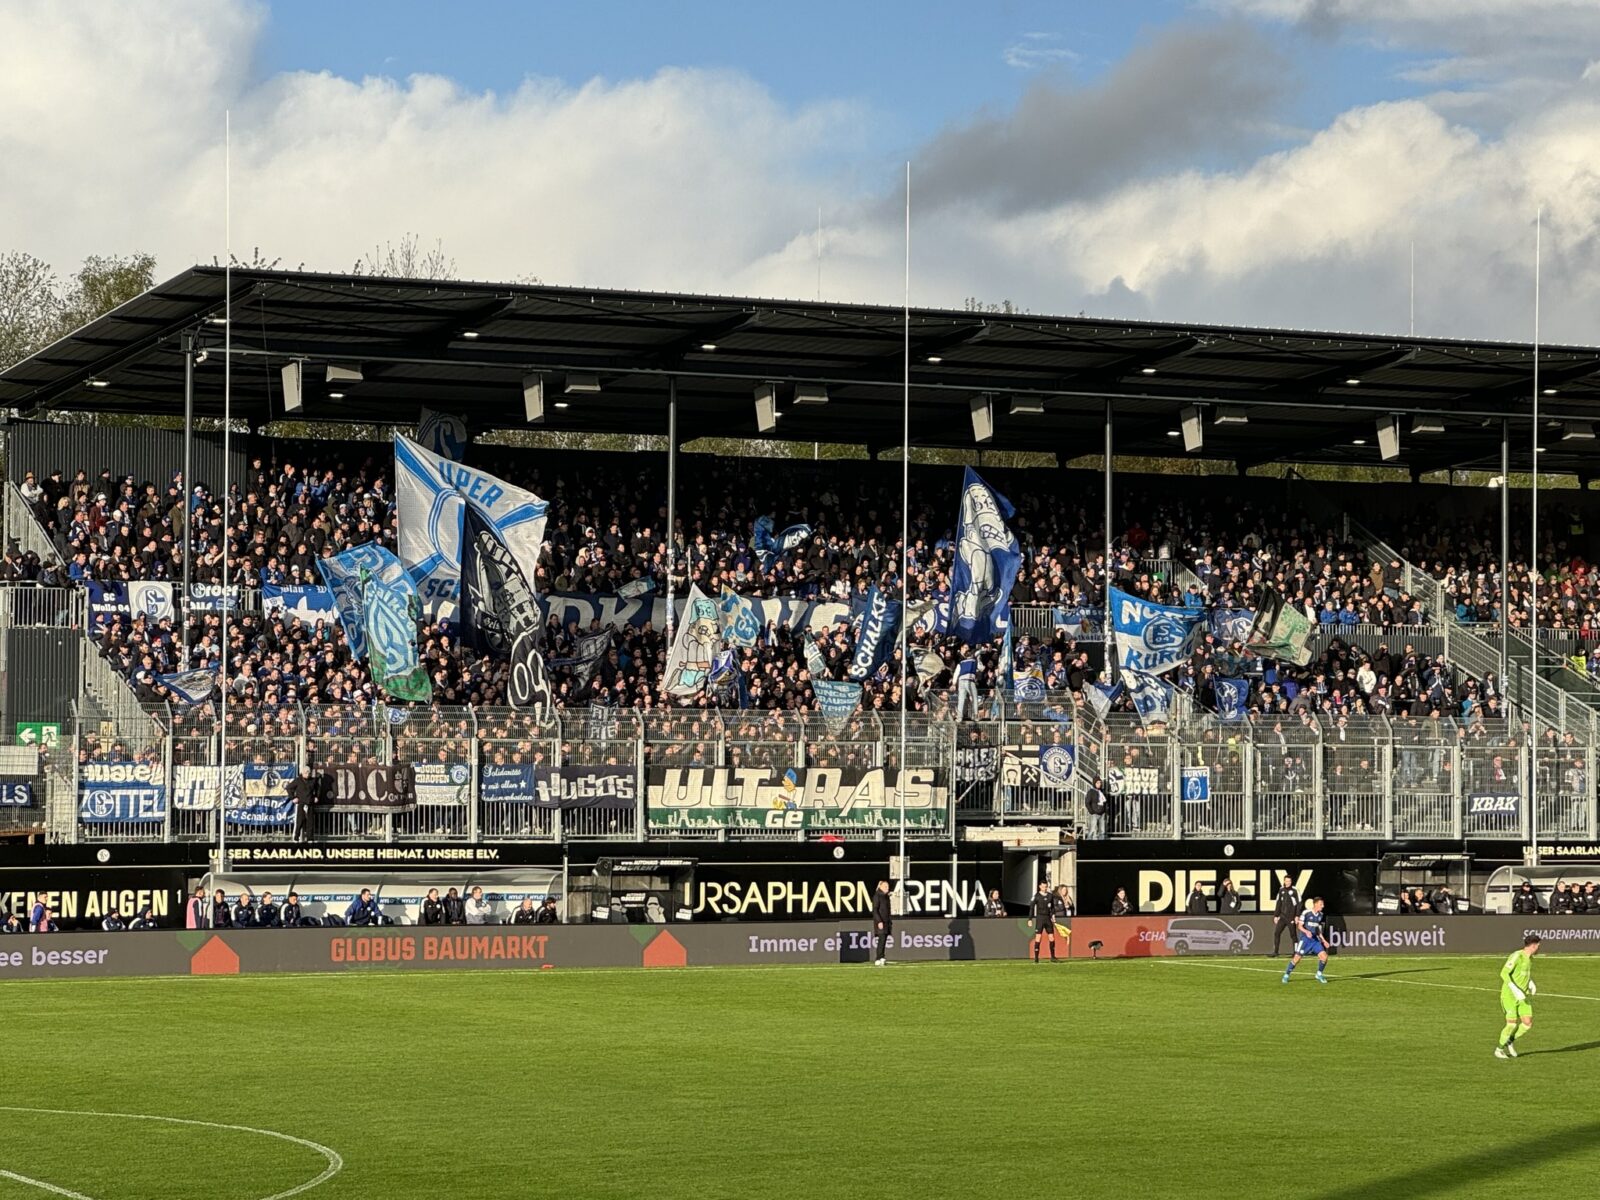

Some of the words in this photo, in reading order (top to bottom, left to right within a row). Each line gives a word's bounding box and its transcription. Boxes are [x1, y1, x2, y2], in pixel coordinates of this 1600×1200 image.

[103, 593, 116, 602] SC
[851, 592, 887, 678] SCHALKE
[0, 784, 28, 804] LS
[661, 768, 934, 813] ULTRAS
[1470, 796, 1518, 812] KBAK
[276, 812, 288, 821] 04
[326, 849, 374, 859] UNSERE
[377, 849, 424, 859] HEIMAT.
[427, 849, 474, 859] UNSERE
[476, 849, 499, 859] ELV.
[1138, 870, 1217, 912] DIE
[85, 889, 169, 917] AUGEN
[749, 935, 817, 953] Immer
[901, 931, 963, 949] besser
[1139, 931, 1166, 942] SCHA
[1329, 925, 1446, 947] bundesweit
[32, 946, 108, 966] besser
[331, 937, 416, 962] GLOBUS
[423, 936, 548, 960] BAUMARKT
